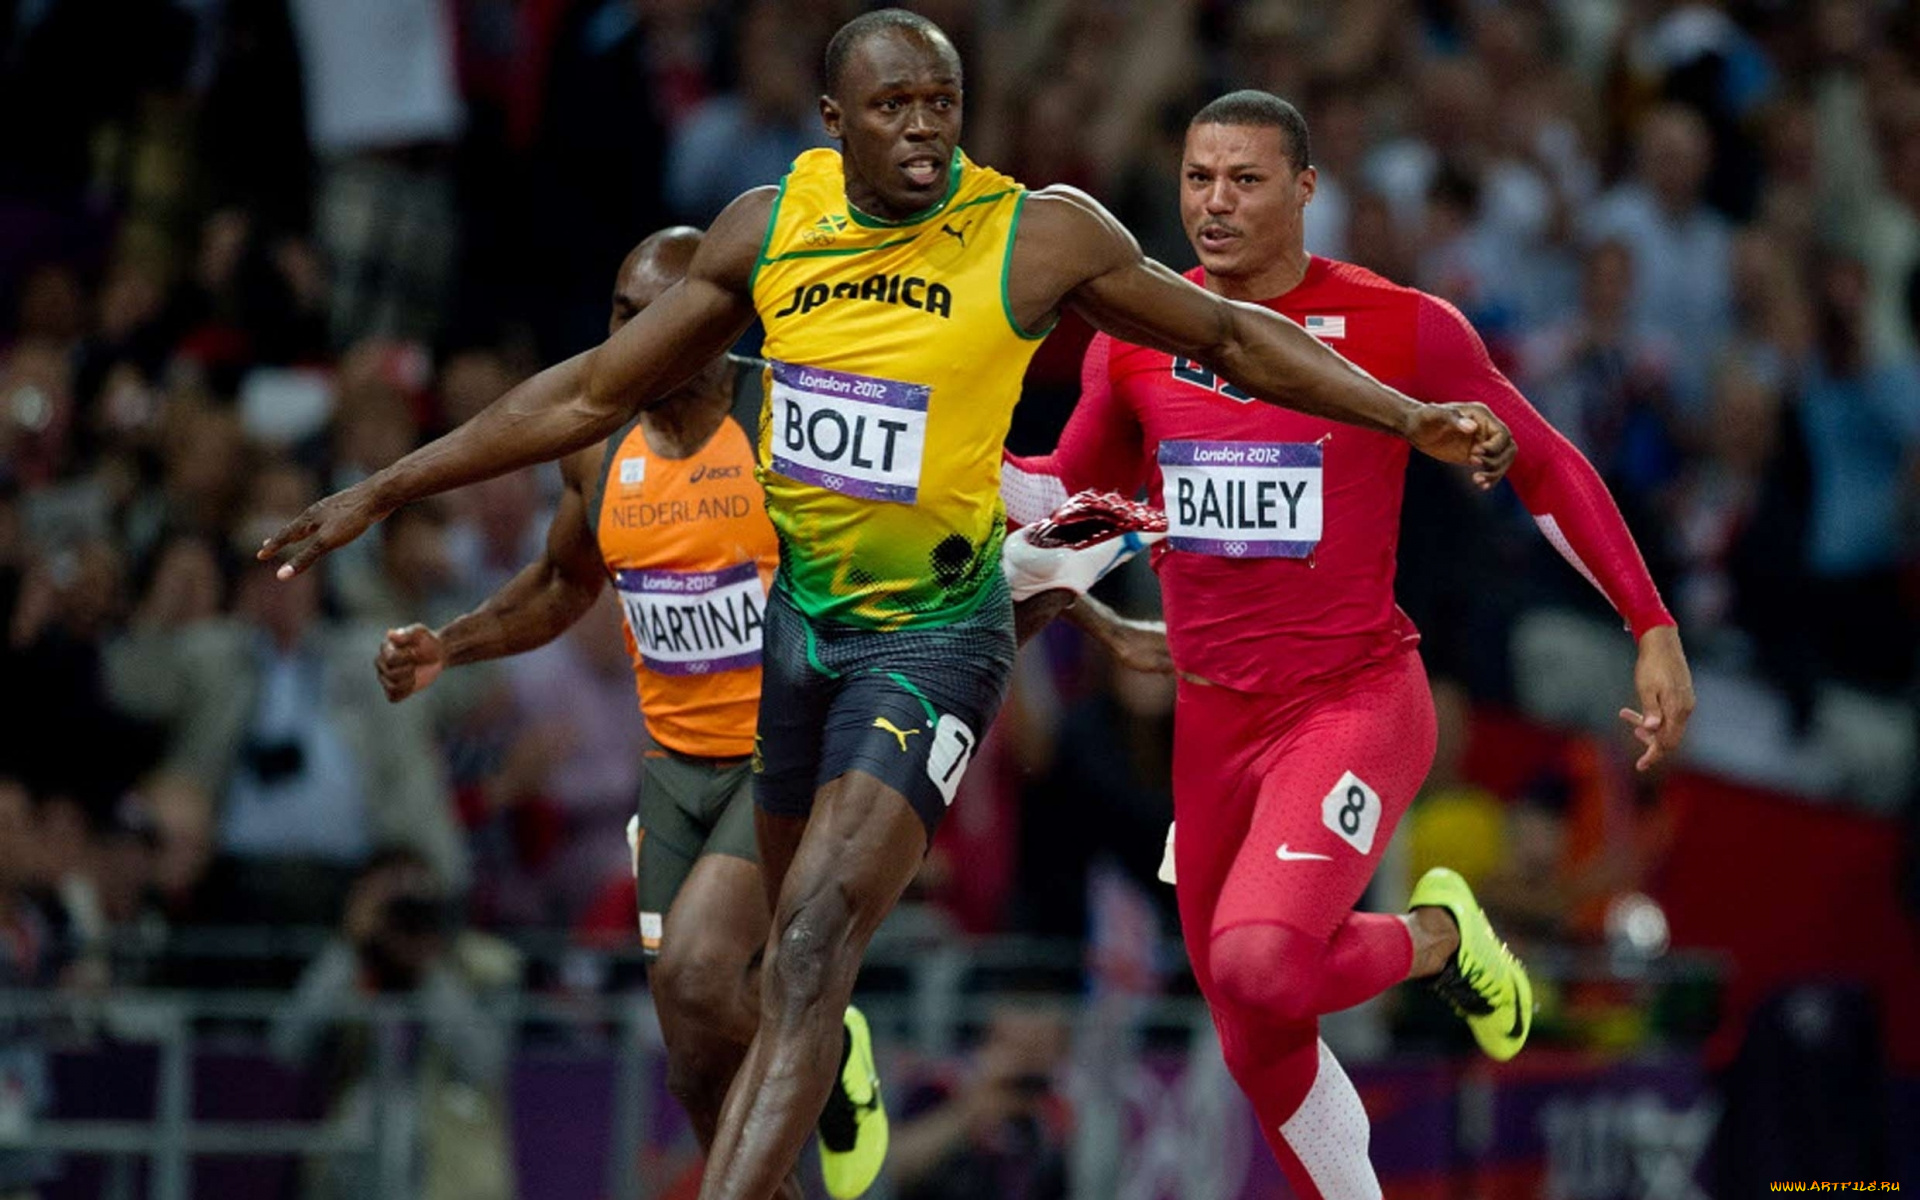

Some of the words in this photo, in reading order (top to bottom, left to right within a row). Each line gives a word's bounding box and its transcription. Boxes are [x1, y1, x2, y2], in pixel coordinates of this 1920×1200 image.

[775, 274, 952, 318] JAMAICA
[798, 371, 851, 393] London
[853, 380, 887, 399] 2012
[784, 399, 908, 473] BOLT
[1193, 446, 1244, 463] London
[1247, 447, 1280, 464] 2012
[612, 496, 750, 527] NEDERLAND
[1178, 477, 1308, 530] BAILEY
[642, 575, 685, 592] London
[686, 576, 717, 589] 2012
[627, 591, 764, 652] MARTINA
[942, 730, 969, 784] 7
[1338, 785, 1366, 837] 8
